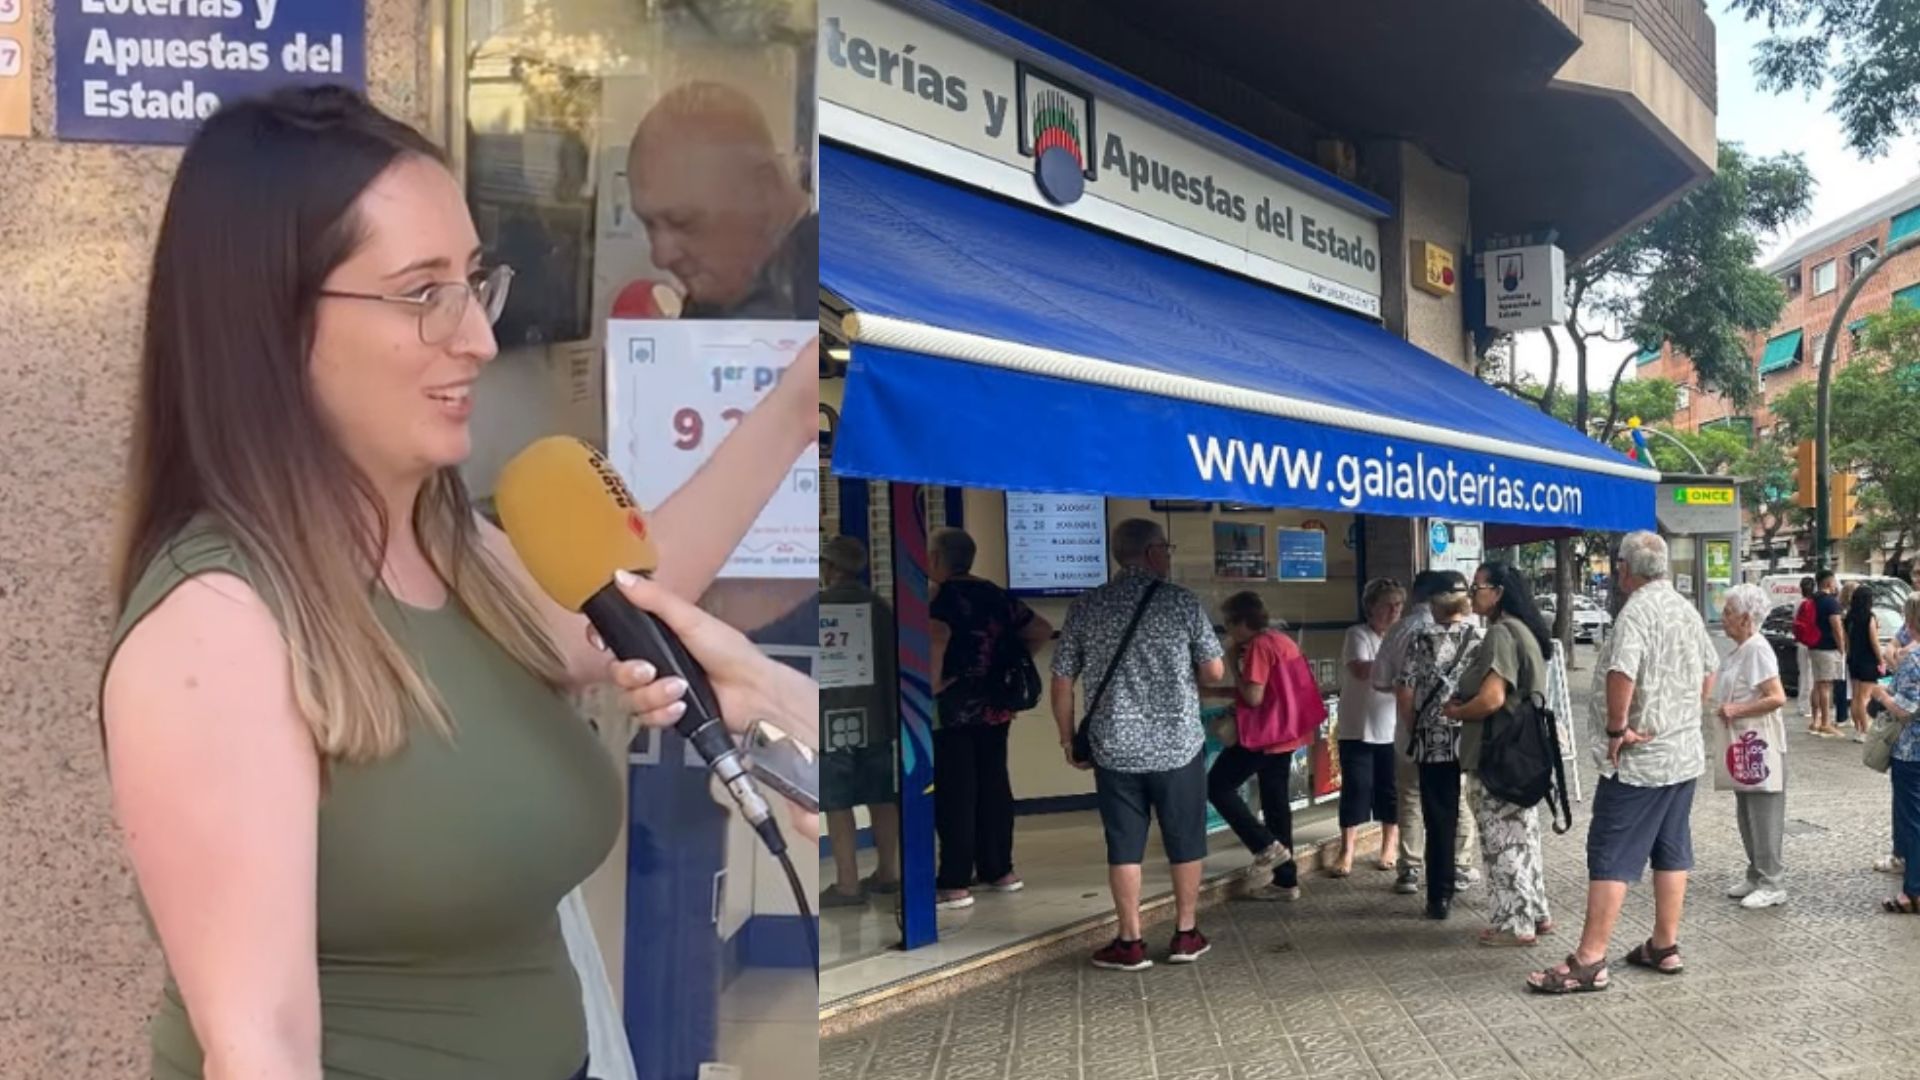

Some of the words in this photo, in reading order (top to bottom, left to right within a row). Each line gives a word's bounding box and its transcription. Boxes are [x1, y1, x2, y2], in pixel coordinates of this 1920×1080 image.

[255, 0, 278, 30] y
[84, 29, 270, 76] Apuestas
[282, 33, 343, 73] del
[83, 80, 220, 120] Estado
[983, 88, 1008, 138] y
[1102, 132, 1247, 223] Apuestas
[1255, 197, 1293, 242] del
[1301, 215, 1377, 274] Estado
[1187, 433, 1582, 516] www.gaialoterias.com
[1692, 491, 1729, 501] ONCE
